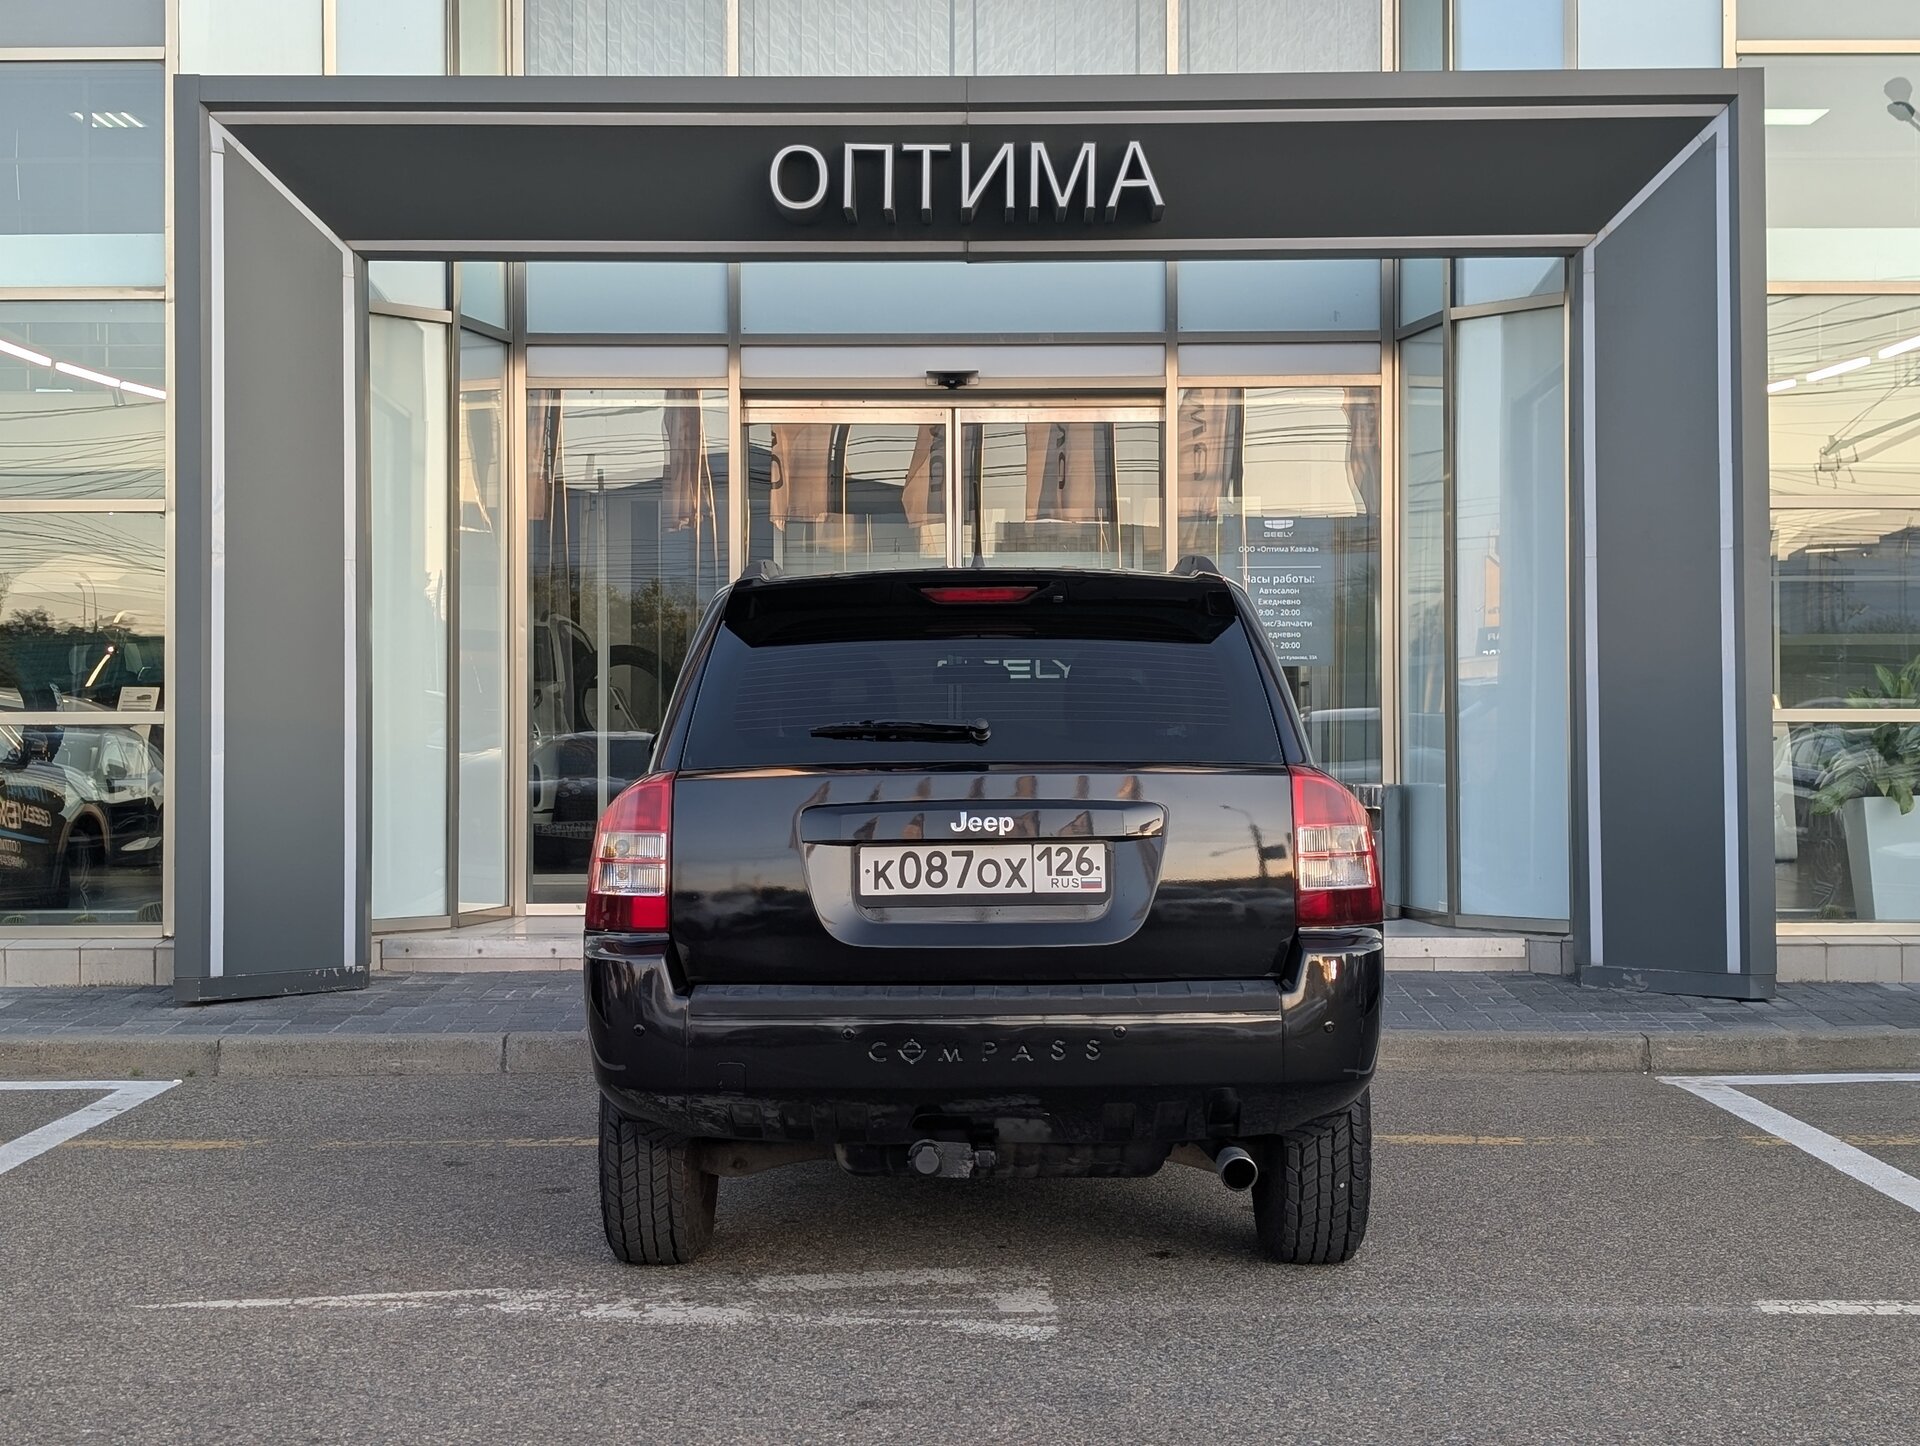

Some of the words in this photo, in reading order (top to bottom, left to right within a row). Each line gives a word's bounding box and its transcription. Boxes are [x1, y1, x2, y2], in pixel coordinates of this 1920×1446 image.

[769, 140, 1166, 214] ОПТИМА
[1243, 574, 1271, 584] Часы
[1273, 573, 1315, 586] работы:
[1258, 587, 1300, 595] Автосалон
[1257, 598, 1301, 607] Ежедневно
[1280, 609, 1301, 617] 20:00
[1268, 632, 1301, 640] едневно
[937, 659, 1072, 680] ELY
[950, 811, 1015, 836] Jeep
[1036, 846, 1094, 876] 126
[1051, 877, 1080, 889] RUS
[868, 1038, 1102, 1064] COMPASS
